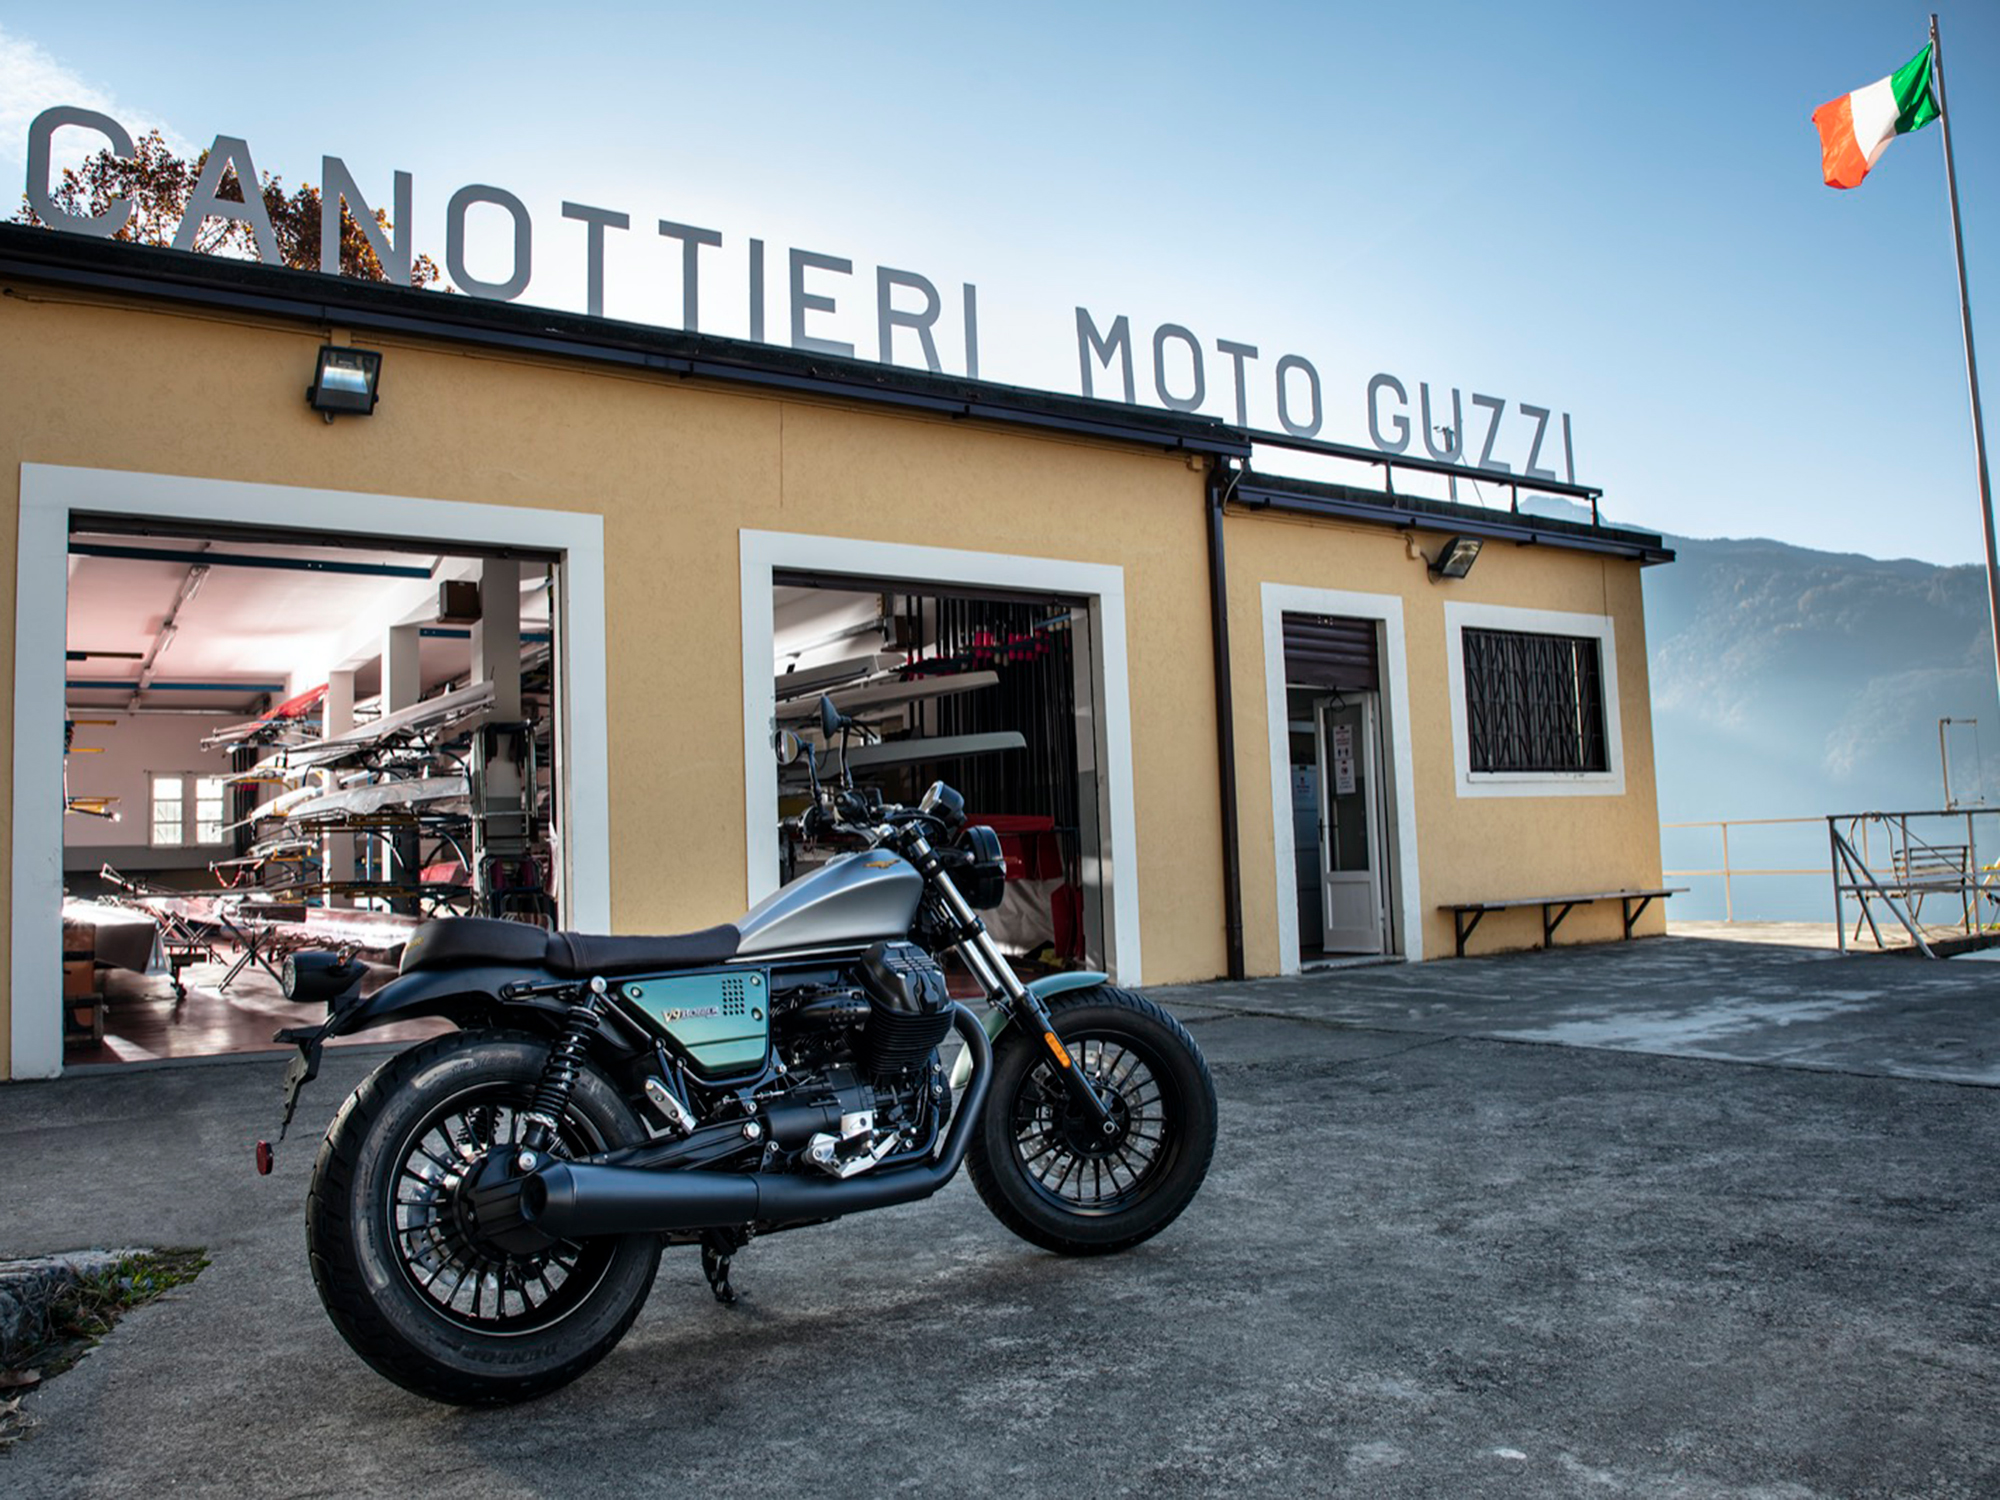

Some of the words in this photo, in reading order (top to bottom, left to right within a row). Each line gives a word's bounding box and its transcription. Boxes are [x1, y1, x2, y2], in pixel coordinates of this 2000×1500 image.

[26, 106, 979, 380] CANOTTIERI
[1075, 306, 1323, 439] MOTO
[1366, 372, 1575, 485] GUZZI
